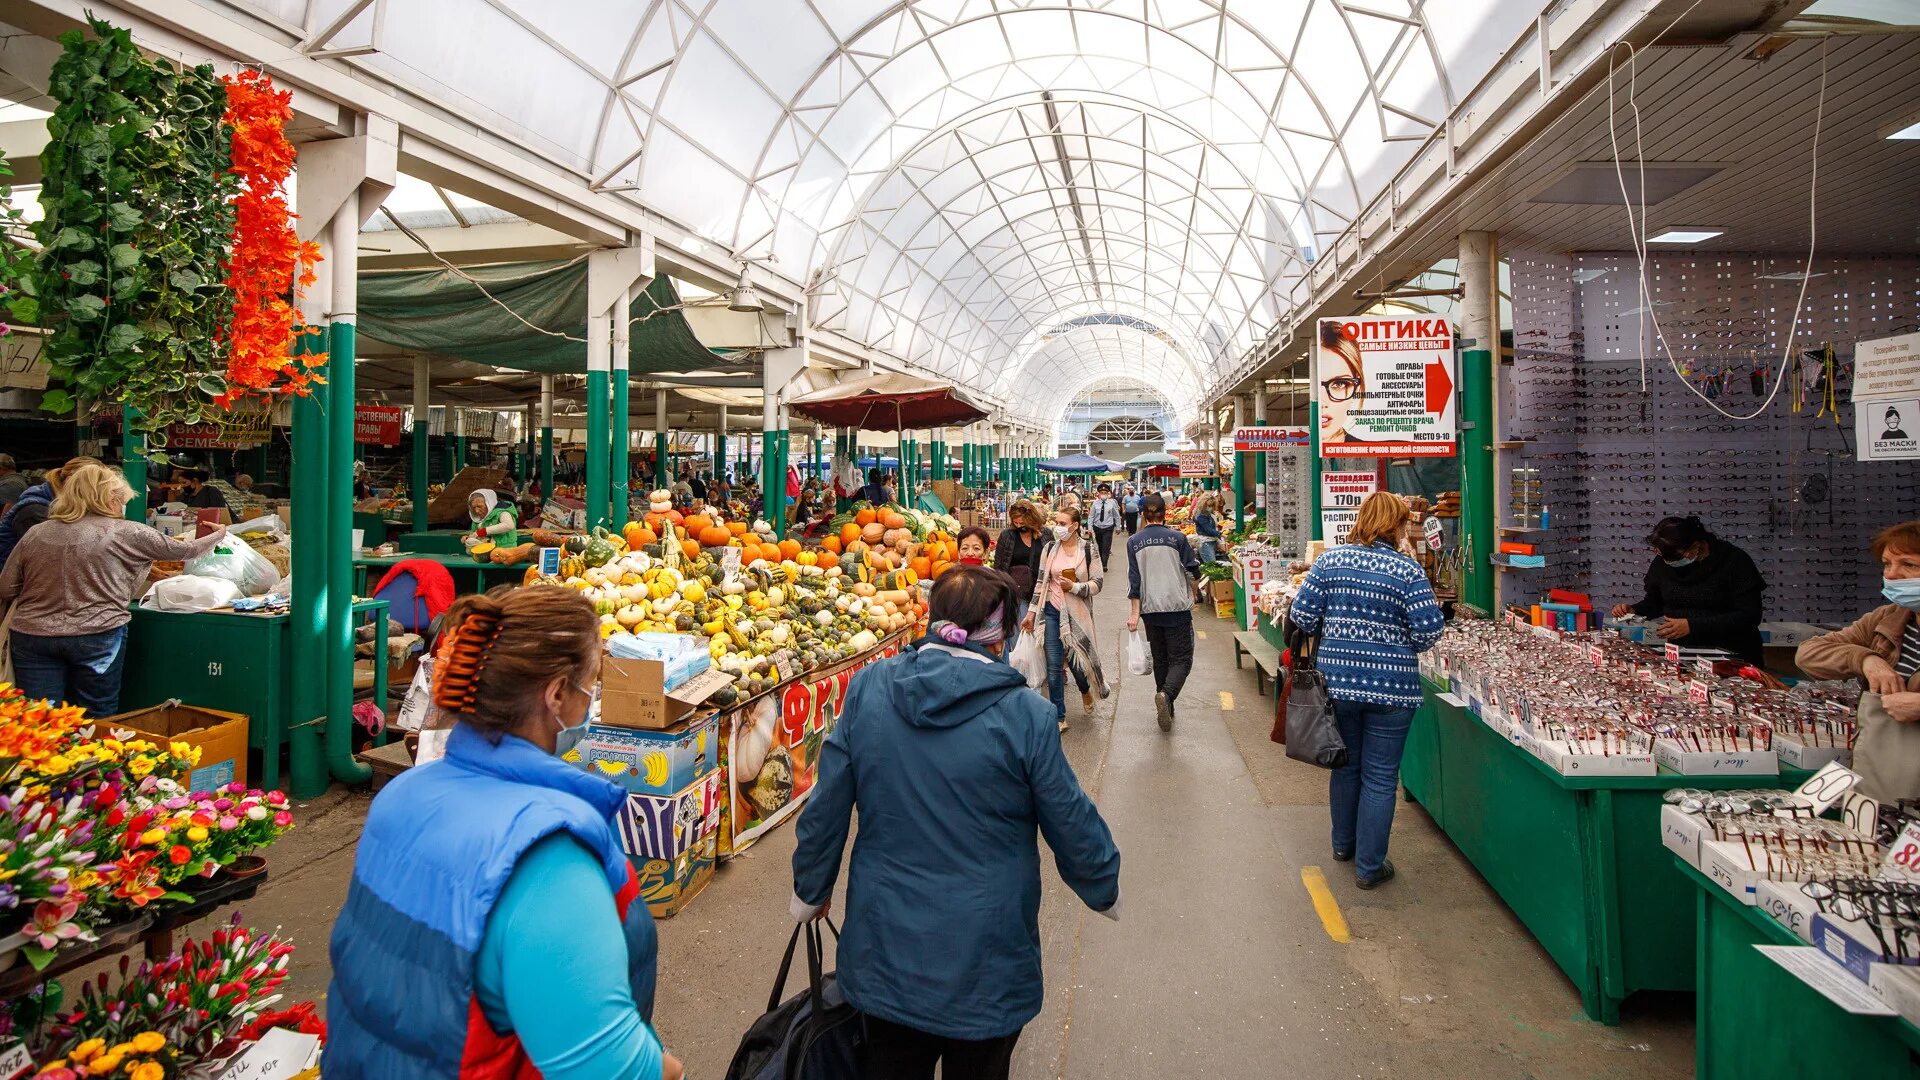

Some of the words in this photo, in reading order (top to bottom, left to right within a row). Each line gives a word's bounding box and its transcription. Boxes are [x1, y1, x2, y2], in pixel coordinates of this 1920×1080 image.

[1342, 319, 1451, 341] ОПТИКА
[1359, 341, 1387, 351] САМЫЕ
[1388, 340, 1418, 351] НИЗКИЕ
[1396, 362, 1424, 370] ОПРАВЫ
[1376, 372, 1405, 380] ГОТОВЫЕ
[1406, 371, 1424, 380] ОЧКИ
[1381, 381, 1424, 390] АКСЕССУАРЫ
[1353, 390, 1406, 399] КОМПЬЮТЕРНЫЕ
[1406, 390, 1424, 399] ОЧКИ
[1387, 400, 1424, 409] АНТИФАРЫ
[1355, 417, 1376, 425] ЗАКАЗ
[1376, 417, 1386, 425] ПО
[1386, 417, 1413, 425] РЕЦЕПТУ
[1413, 416, 1434, 425] ВРАЧА
[1369, 424, 1395, 432] РЕМОНТ
[1395, 424, 1418, 432] ОЧКОВ
[1413, 432, 1435, 440] МЕСТО
[1435, 432, 1450, 440] 9-10
[1248, 441, 1298, 451] распродажа
[1325, 446, 1369, 454] ИЗГОТОВЛЕНИЕ
[1369, 446, 1389, 454] ОЧКОВ
[1390, 445, 1412, 454] ЛЮБОЙ
[1412, 445, 1450, 454] СЛОЖНОСТИ
[1324, 474, 1374, 483] Распродажа
[1334, 494, 1362, 506] 170р
[1133, 537, 1164, 550] adidas
[207, 661, 222, 676] 131
[589, 748, 636, 767] Banafood
[1801, 768, 1855, 802] 60
[1842, 793, 1876, 838] 60
